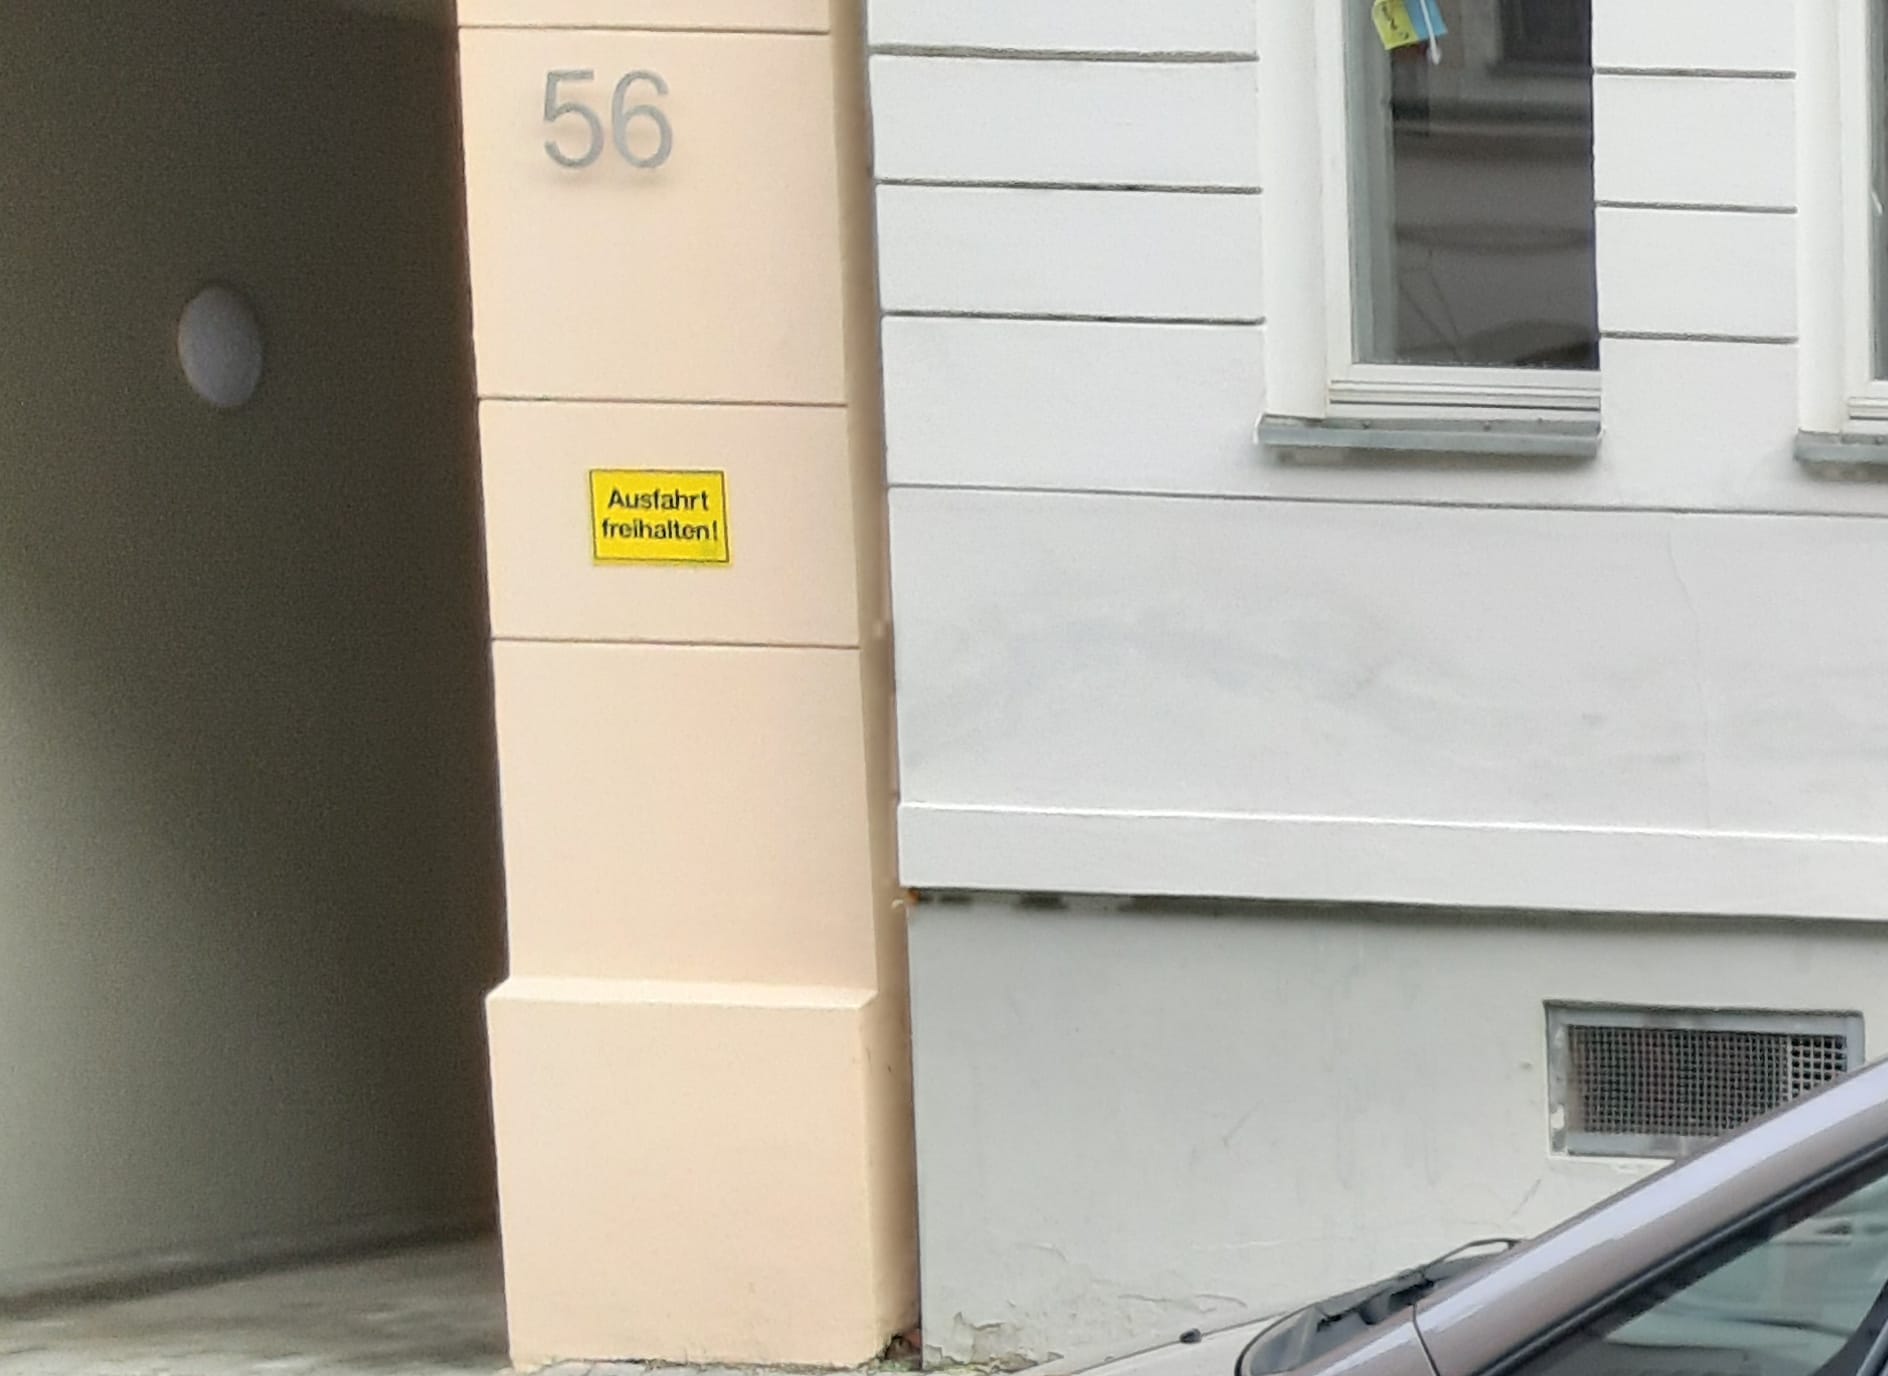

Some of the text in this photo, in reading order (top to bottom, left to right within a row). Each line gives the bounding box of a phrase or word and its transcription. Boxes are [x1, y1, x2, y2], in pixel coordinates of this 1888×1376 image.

[543, 69, 673, 169] 56
[608, 488, 709, 511] Ausfahrt
[602, 518, 718, 541] freihalten!
